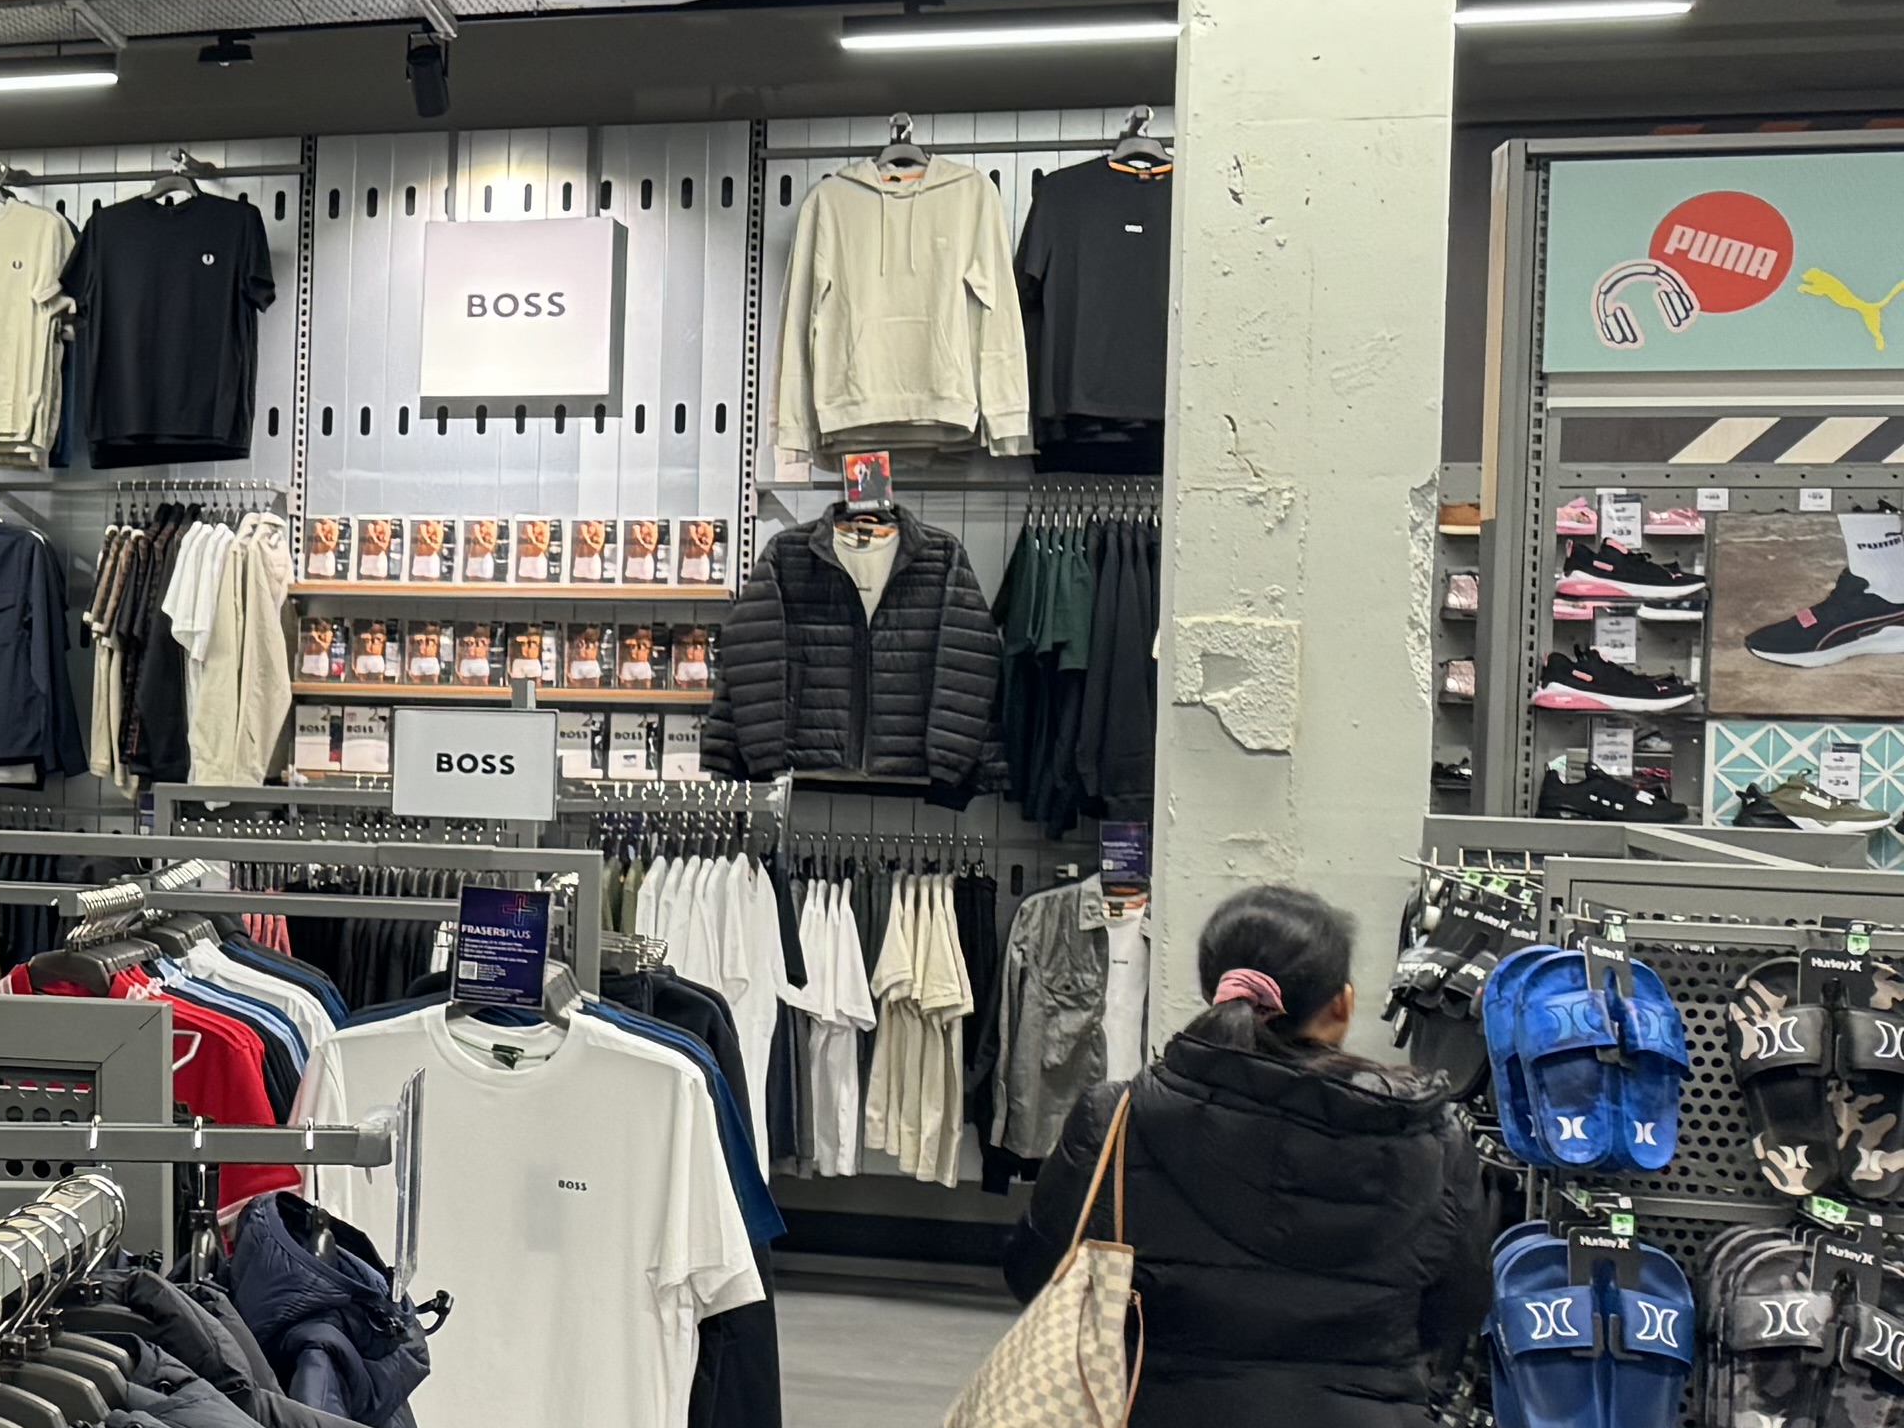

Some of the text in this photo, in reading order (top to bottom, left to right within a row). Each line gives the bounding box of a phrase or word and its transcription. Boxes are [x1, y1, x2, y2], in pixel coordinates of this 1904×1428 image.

[1664, 224, 1778, 280] PUMA
[467, 292, 565, 318] BOSS
[436, 752, 515, 775] BOSS
[461, 924, 531, 940] FRASERSPLUS
[558, 1179, 587, 1192] BOSS
